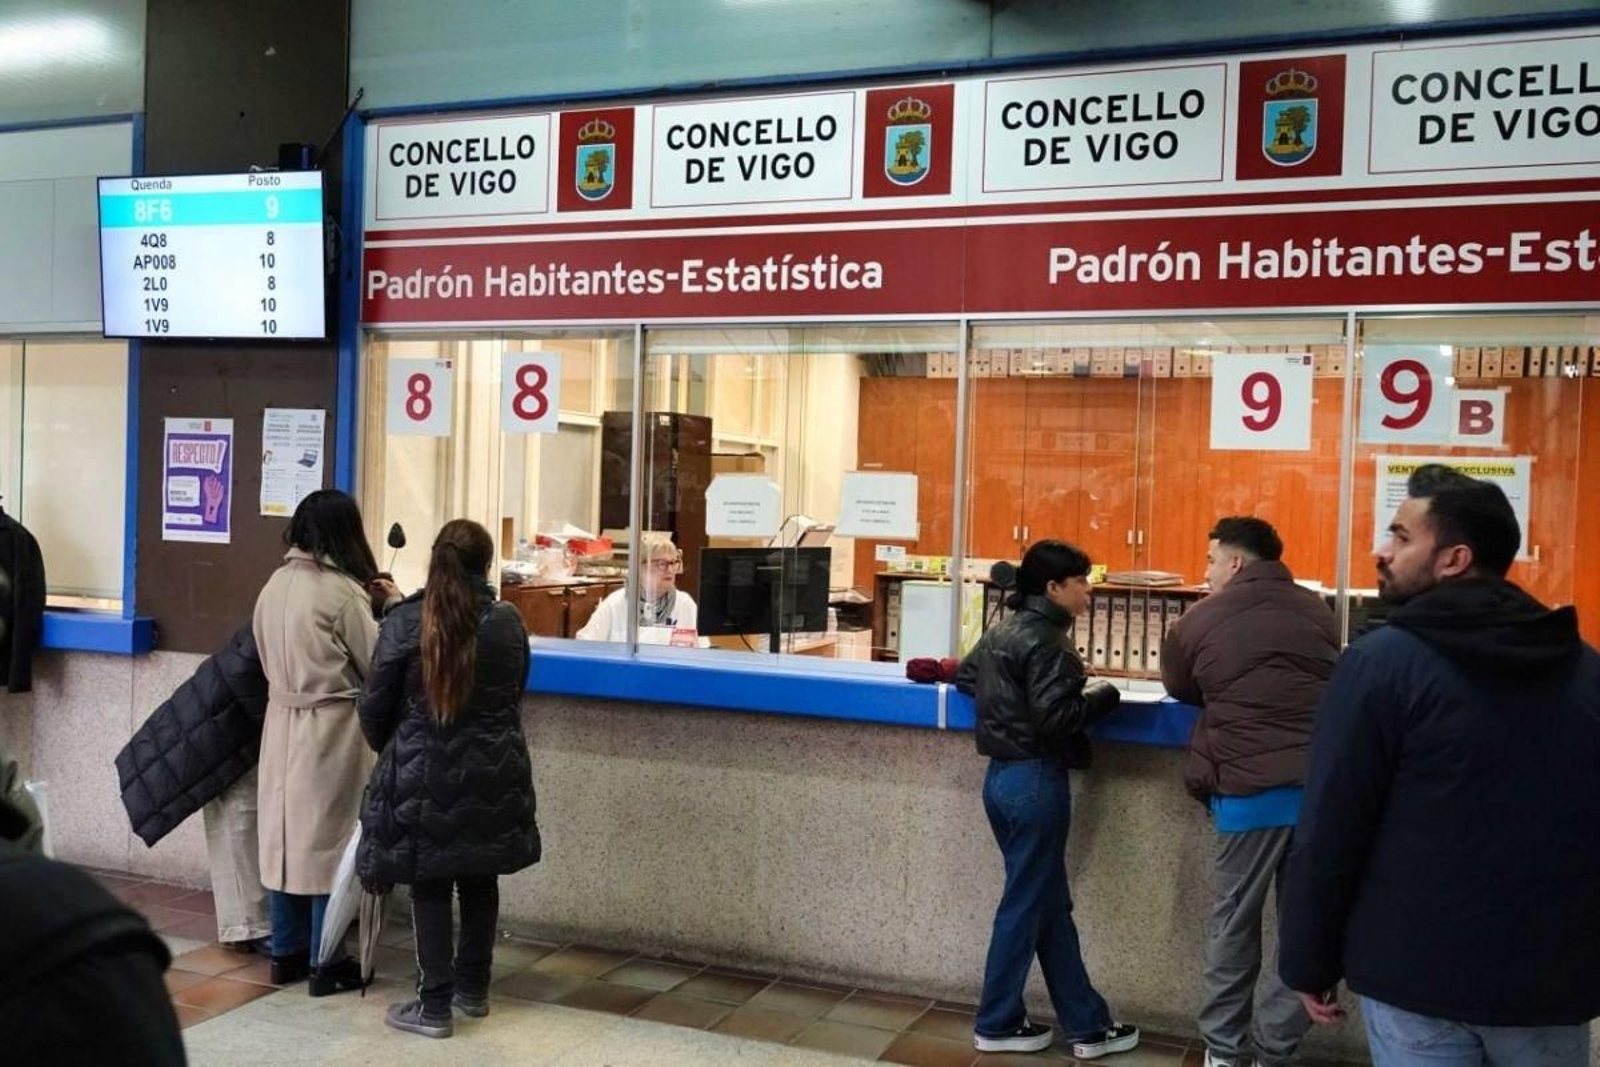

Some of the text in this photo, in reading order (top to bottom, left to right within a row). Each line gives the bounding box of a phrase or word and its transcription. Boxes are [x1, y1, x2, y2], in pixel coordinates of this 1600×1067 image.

[1392, 62, 1600, 105] CONCELL
[1001, 89, 1205, 130] CONCELLO
[1419, 105, 1600, 144] DE VIGO
[666, 115, 837, 150] CONCELLO
[1024, 131, 1179, 166] DE VIGO
[390, 135, 535, 167] CONCELLO
[686, 152, 815, 184] DE VIGO
[131, 175, 281, 191] Quenda Posto
[406, 169, 517, 198] DE VIGO
[134, 195, 279, 222] 8F6 9
[140, 231, 275, 248] 4Q8 8
[1049, 229, 1600, 284] Padrón Habitantes-Est
[133, 253, 275, 270] AP008 10
[368, 254, 883, 300] Padrón Habitantes-Estatística
[143, 276, 276, 291] 2L0 8
[144, 298, 277, 313] 1V9 10
[145, 319, 277, 334] 1V9 10
[405, 373, 433, 421] 8
[512, 363, 549, 421] 8
[1241, 371, 1282, 432] 9
[1380, 359, 1433, 430] 9
[1459, 399, 1494, 435] B
